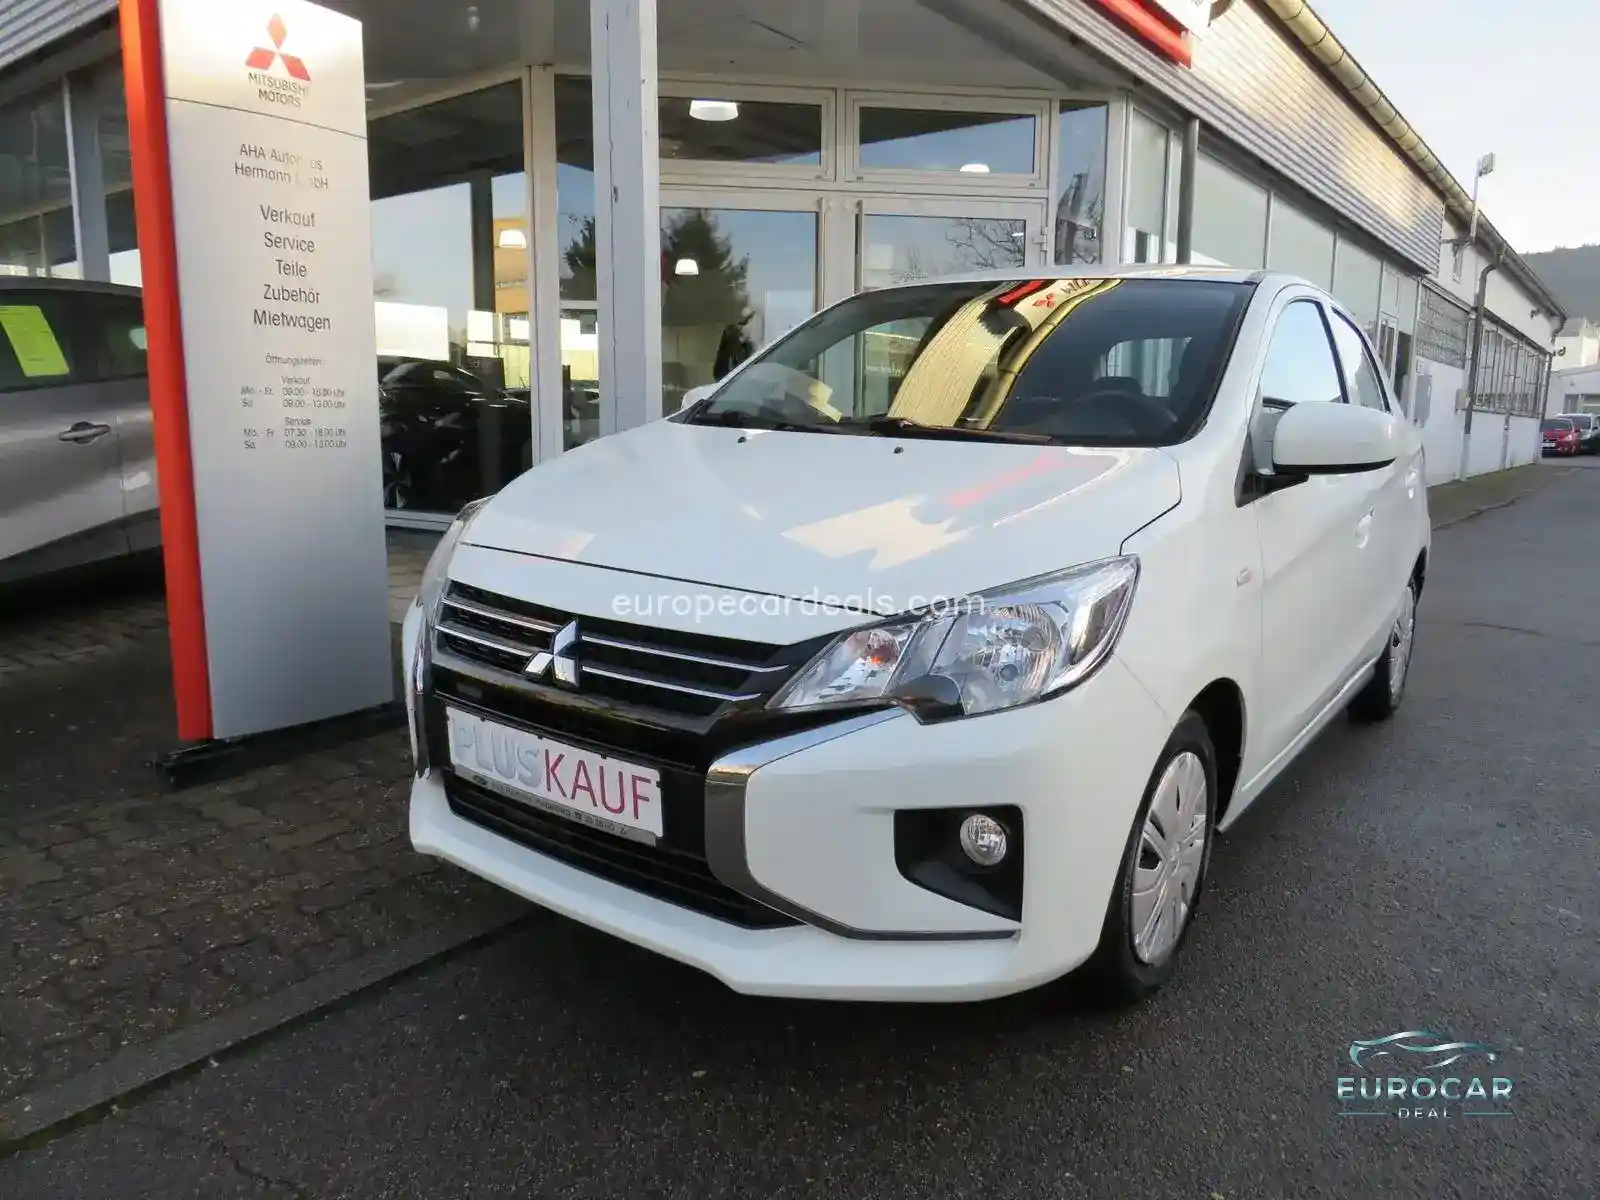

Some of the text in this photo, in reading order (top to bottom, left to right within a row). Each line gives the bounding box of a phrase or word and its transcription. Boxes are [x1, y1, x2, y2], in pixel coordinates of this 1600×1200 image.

[247, 71, 309, 97] MITSUBISHI
[258, 88, 302, 107] MOTORS
[239, 143, 267, 160] AHA
[234, 162, 291, 183] Hermann
[260, 203, 316, 228] Verkauf
[263, 231, 315, 253] Service
[275, 258, 308, 278] Teile
[263, 283, 320, 304] Zubehör
[253, 308, 331, 333] Mietwagen
[281, 375, 311, 385] Verkauf
